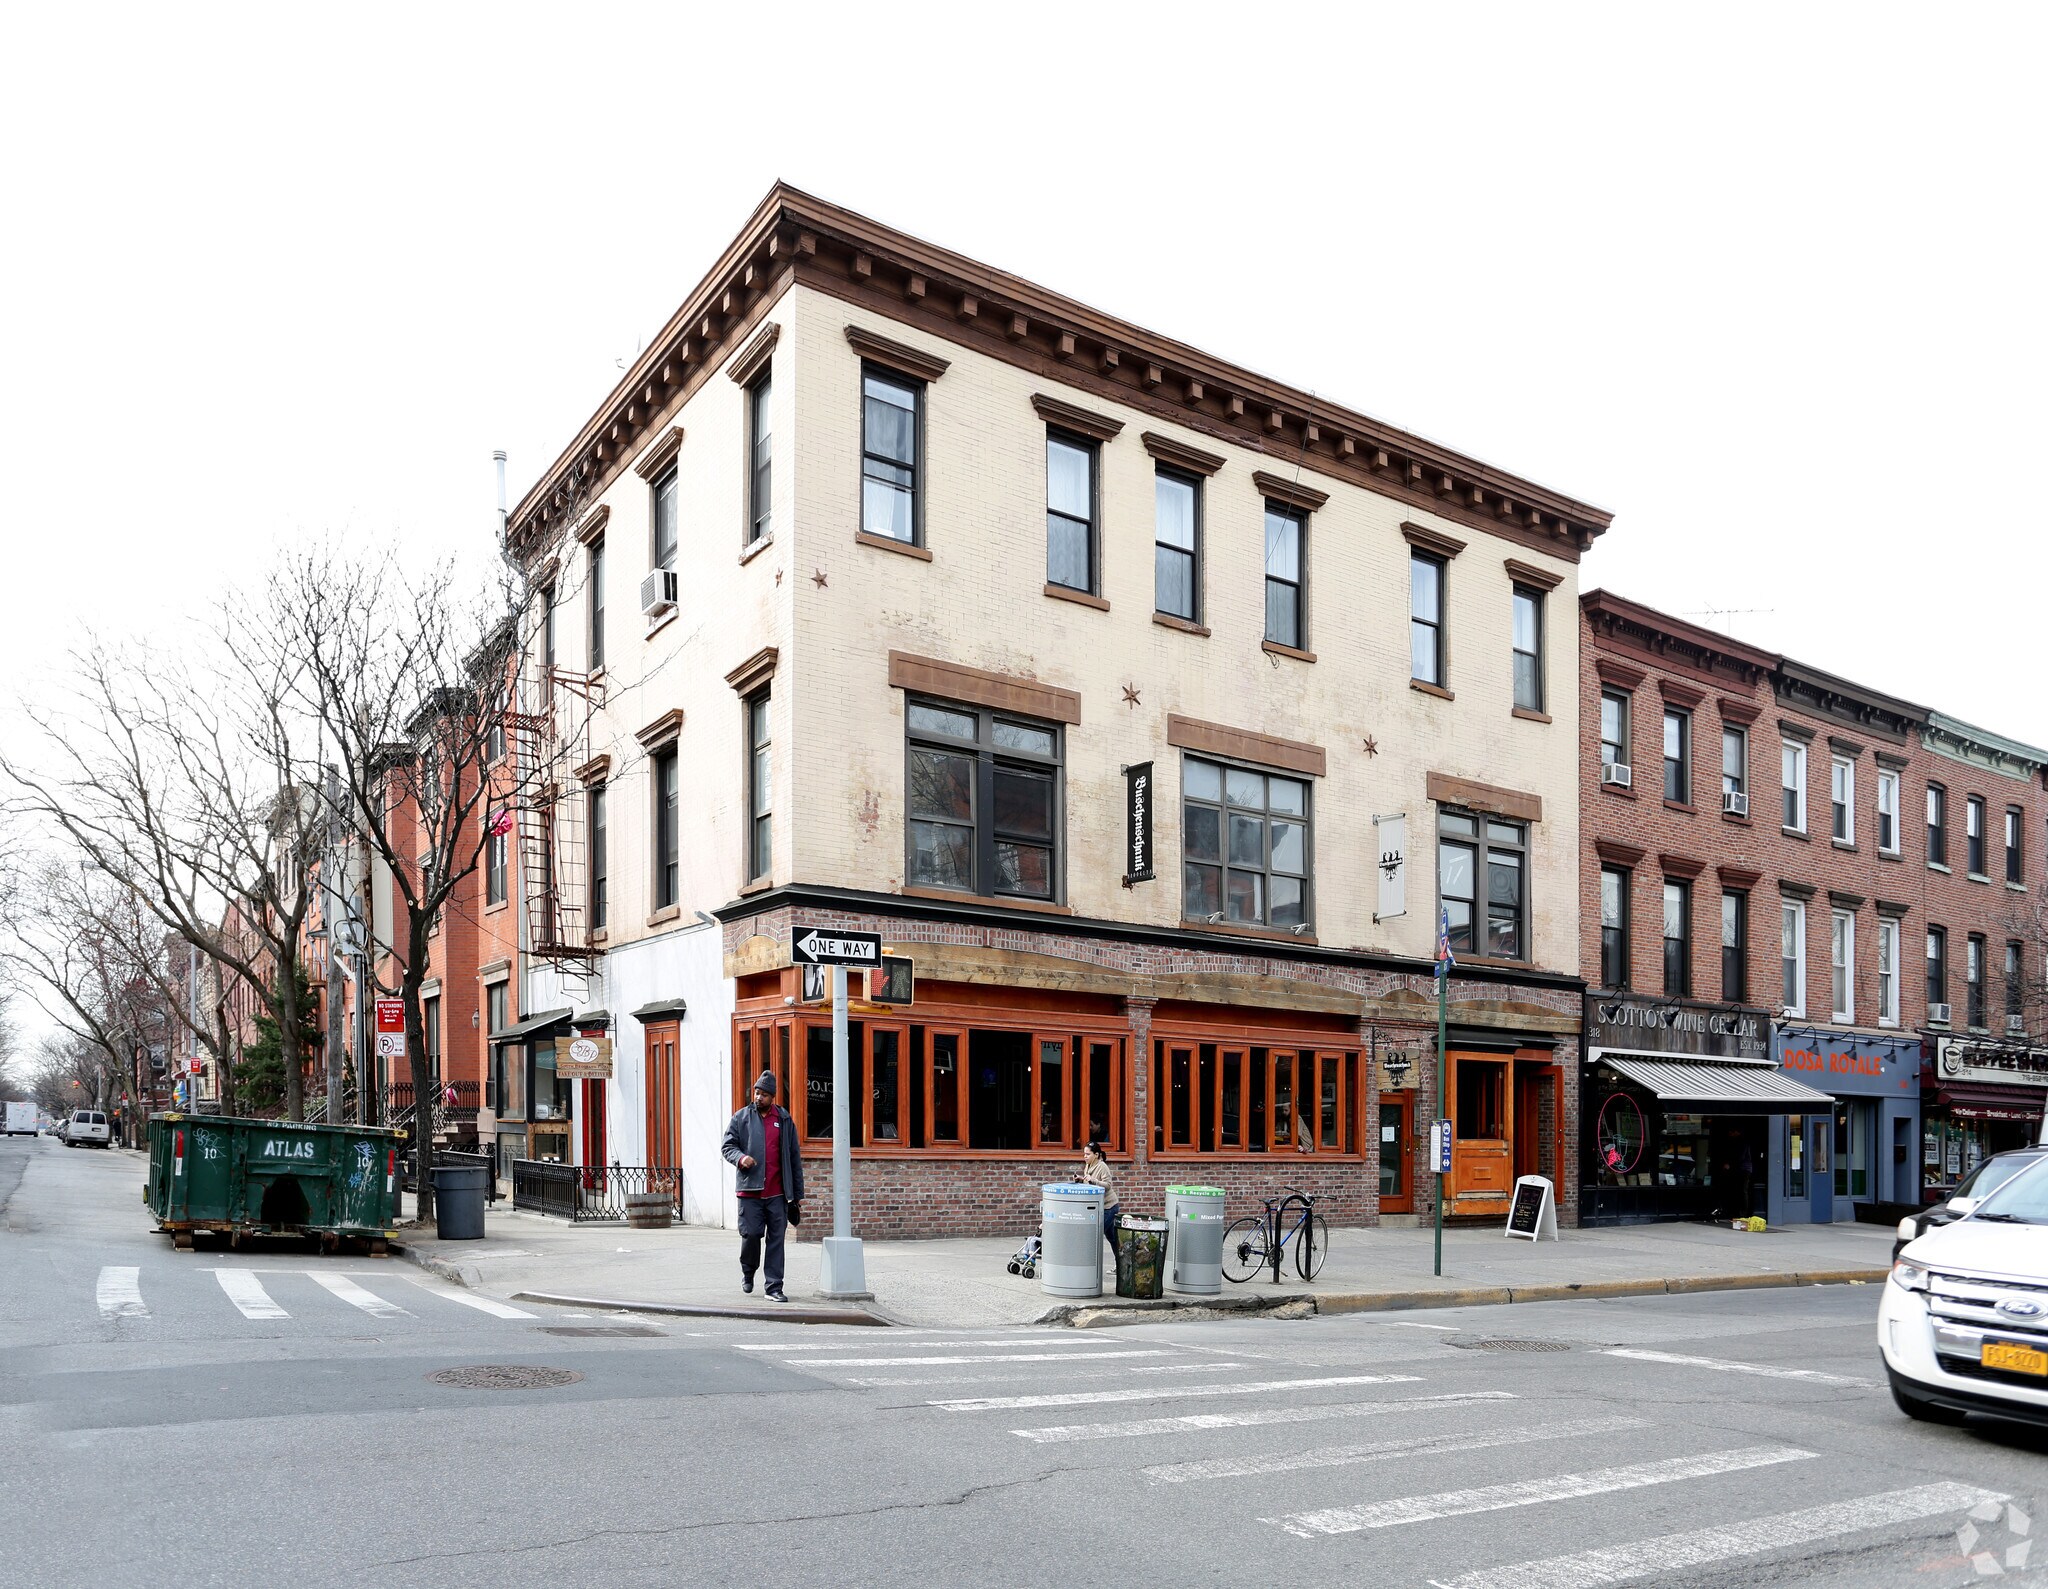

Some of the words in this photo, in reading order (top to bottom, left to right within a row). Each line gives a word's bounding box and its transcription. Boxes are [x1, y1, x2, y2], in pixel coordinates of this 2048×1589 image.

[808, 938, 836, 955] ONE
[842, 941, 870, 957] WAY
[1588, 1026, 1601, 1038] 318
[1784, 1048, 1825, 1072] DOSA
[282, 1122, 317, 1131] PARKING
[204, 1147, 217, 1160] 10
[264, 1139, 315, 1159] ATLAS
[356, 1156, 369, 1168] 10
